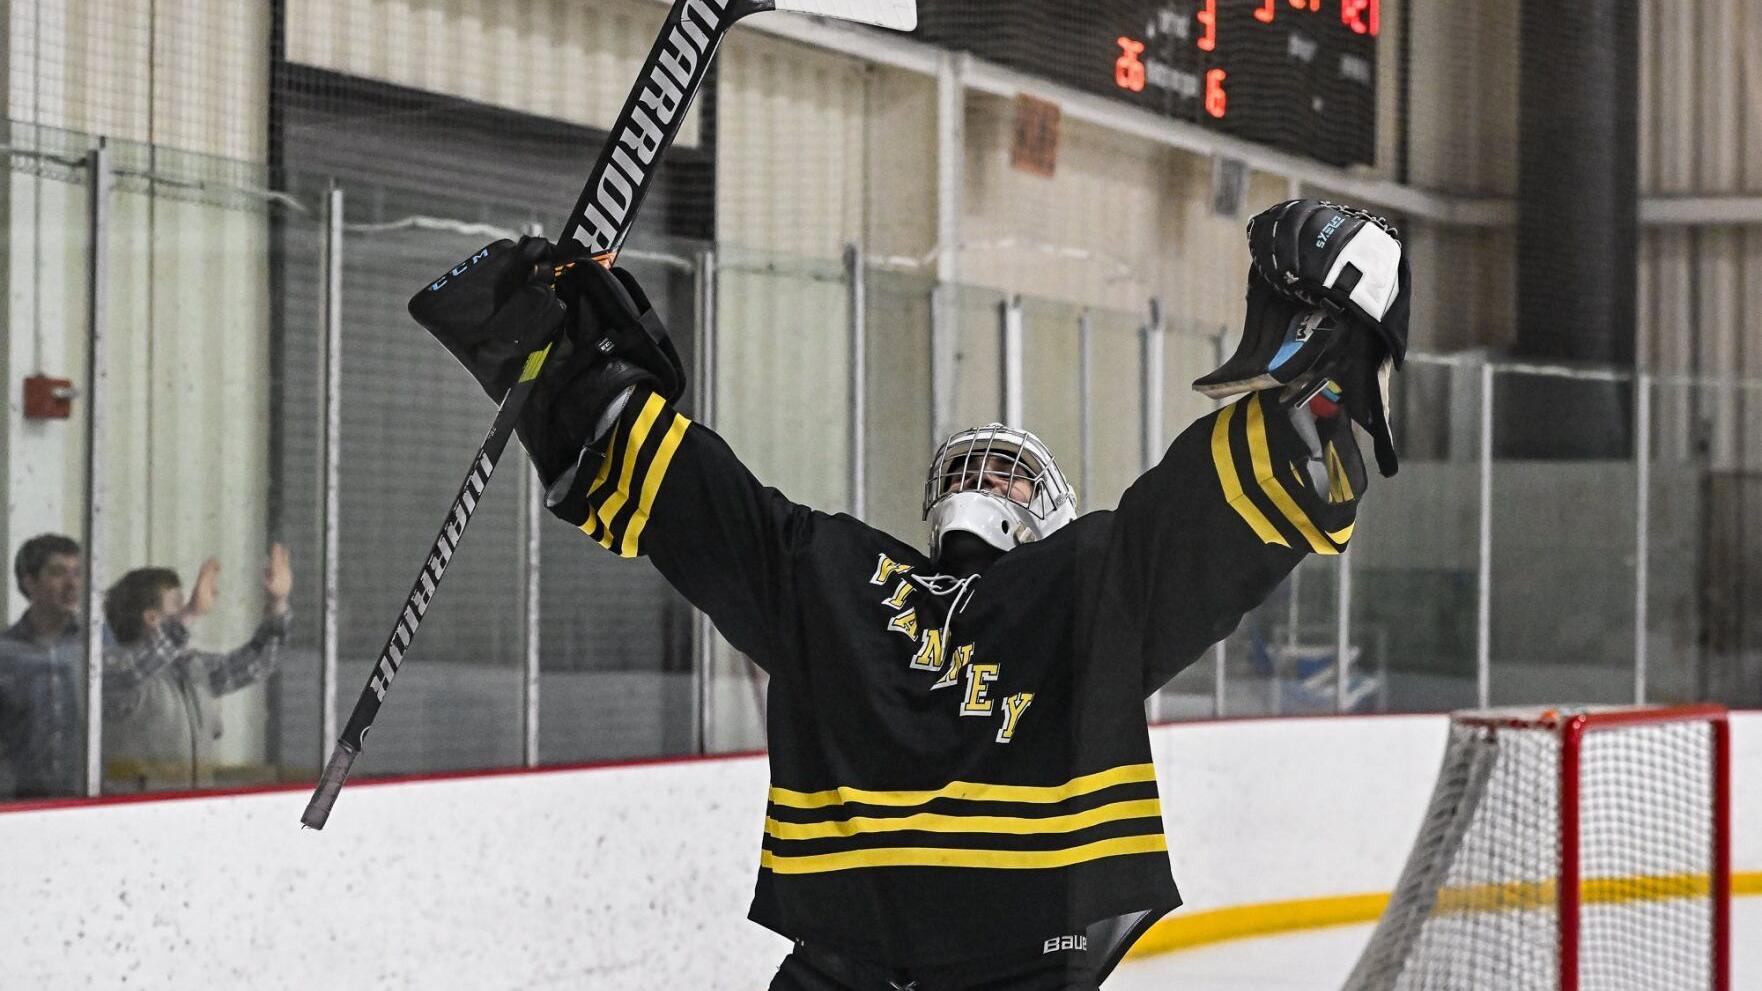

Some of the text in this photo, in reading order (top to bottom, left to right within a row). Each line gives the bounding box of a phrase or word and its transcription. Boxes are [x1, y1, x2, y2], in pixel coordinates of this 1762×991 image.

[573, 0, 728, 253] WARRIOR
[1205, 69, 1227, 118] 6
[431, 248, 489, 291] CCM
[370, 451, 494, 703] WARRIOR
